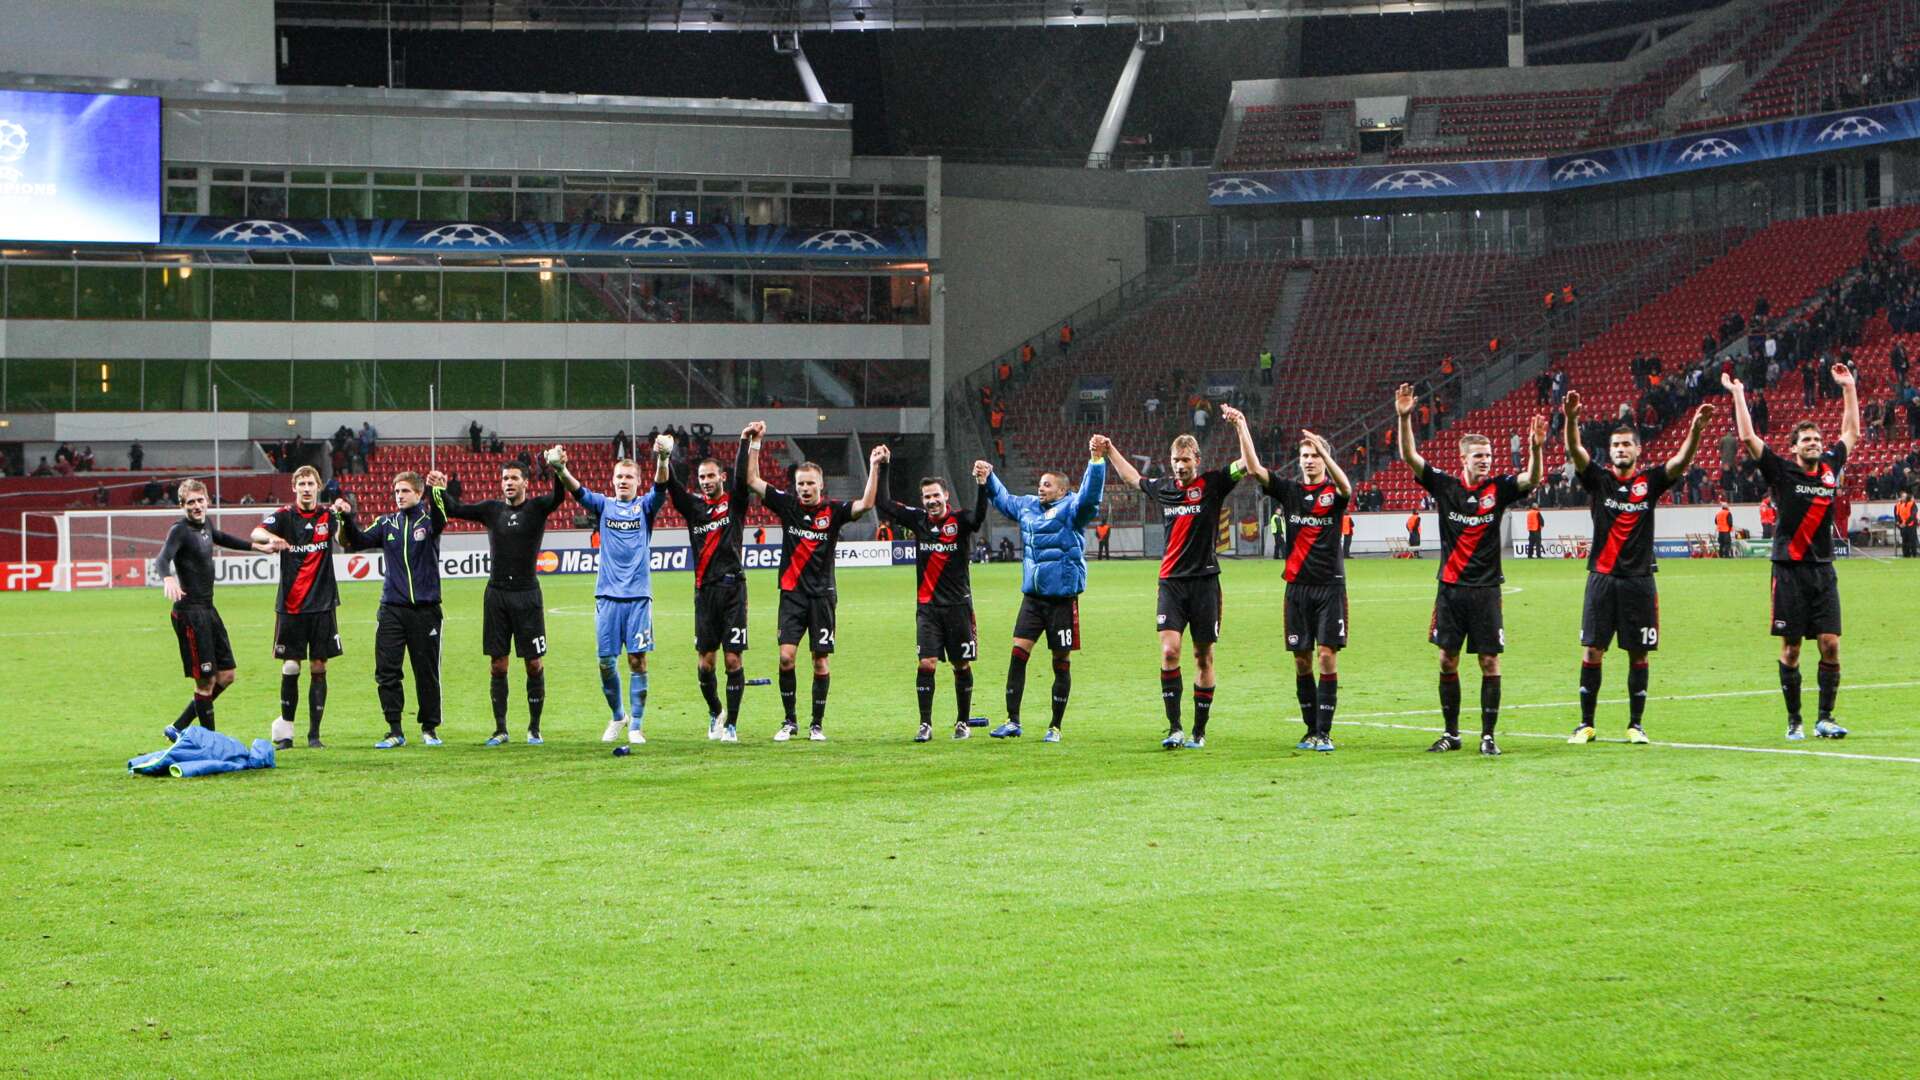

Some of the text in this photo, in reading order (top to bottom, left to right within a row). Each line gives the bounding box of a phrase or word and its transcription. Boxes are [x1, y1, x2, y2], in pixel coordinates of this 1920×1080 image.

[1448, 511, 1494, 526] SUNPOWER
[730, 627, 747, 644] 21
[818, 628, 835, 645] 24
[1058, 629, 1073, 647] 18
[1641, 627, 1658, 645] 19
[532, 636, 547, 653] 13
